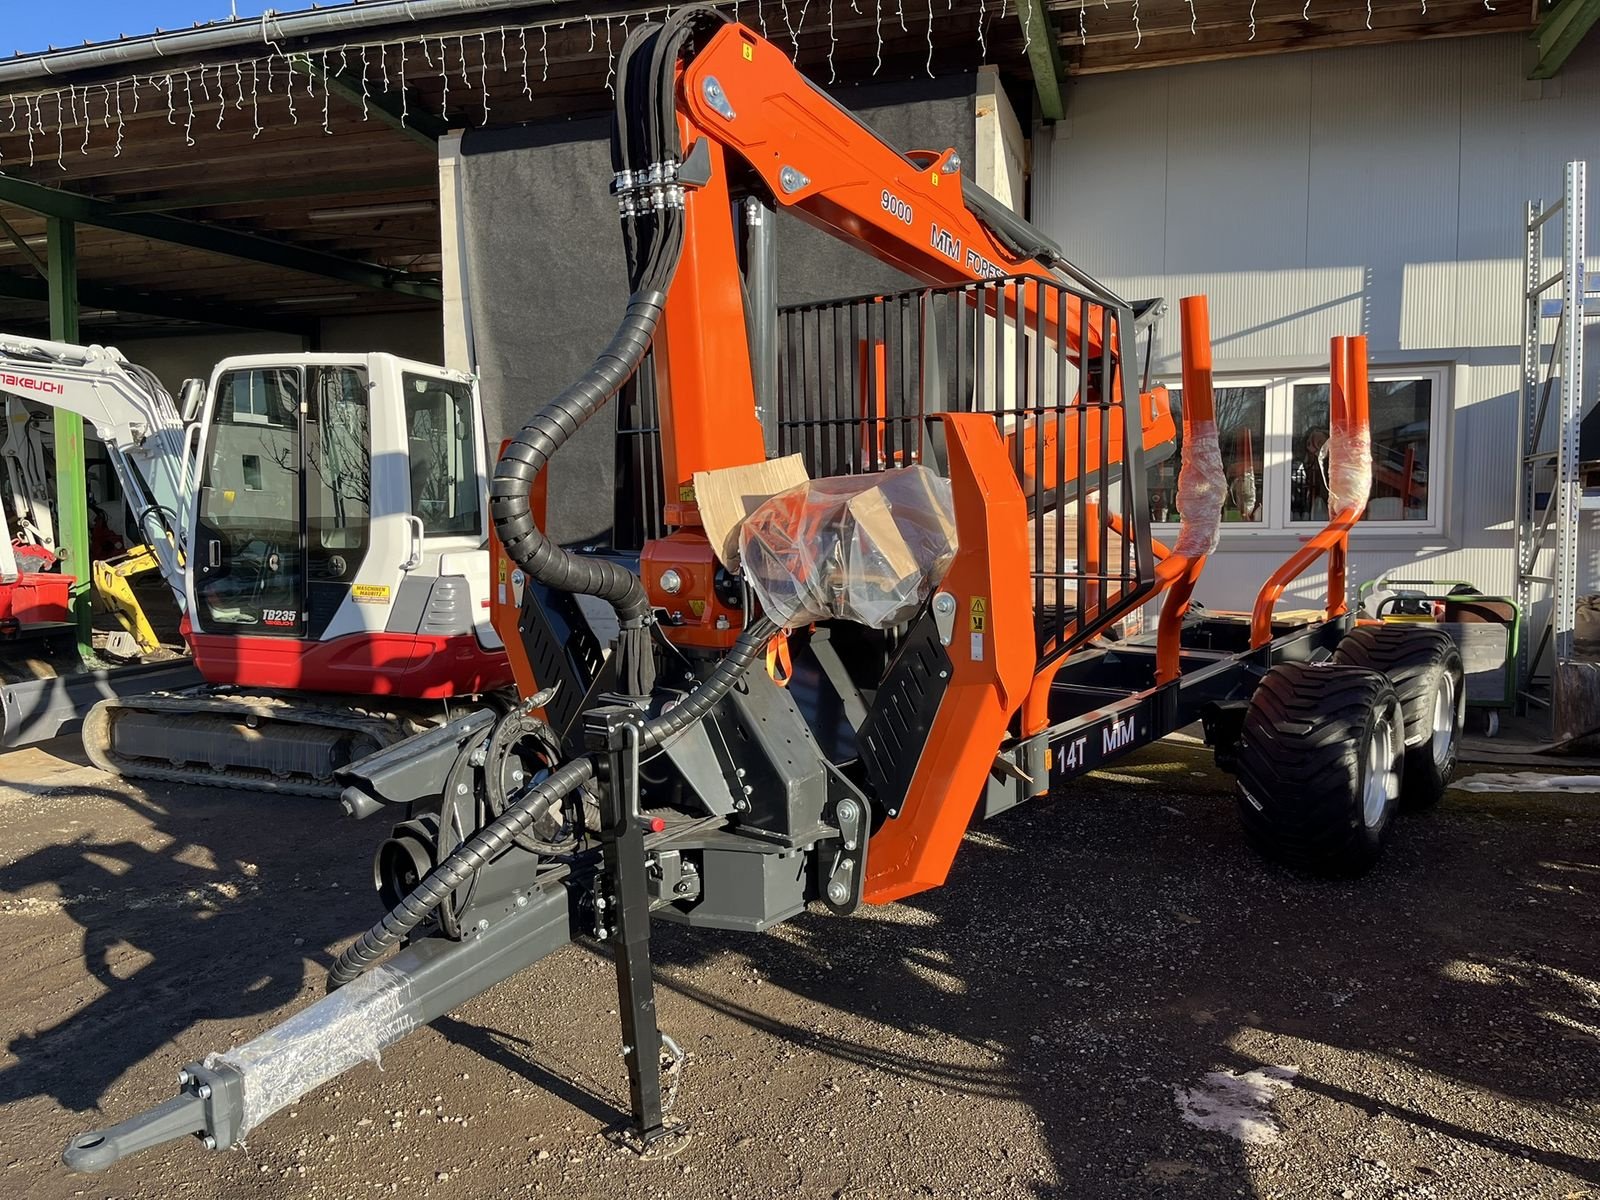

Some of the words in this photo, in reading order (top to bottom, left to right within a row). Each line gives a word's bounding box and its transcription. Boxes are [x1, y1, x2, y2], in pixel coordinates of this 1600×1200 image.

[881, 190, 912, 225] 9000
[931, 222, 961, 263] MTM
[262, 609, 297, 622] TB235
[1057, 736, 1087, 773] 14T
[1102, 715, 1135, 755] MTM
